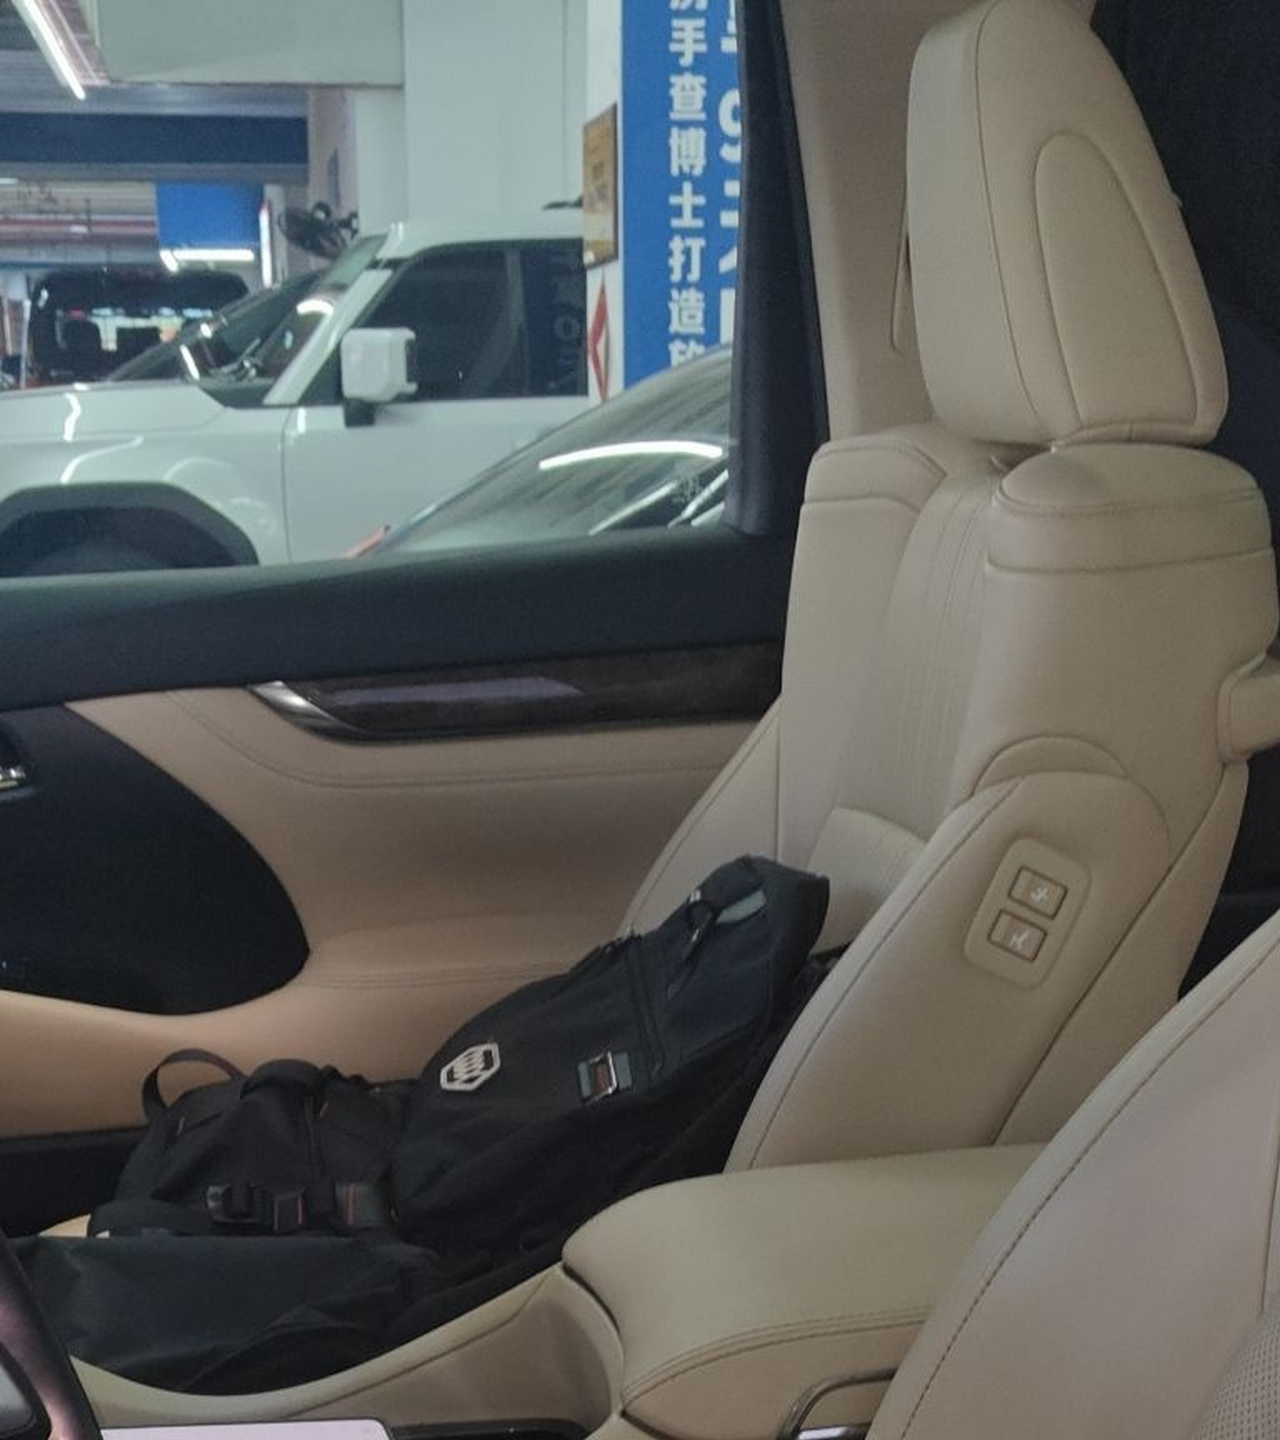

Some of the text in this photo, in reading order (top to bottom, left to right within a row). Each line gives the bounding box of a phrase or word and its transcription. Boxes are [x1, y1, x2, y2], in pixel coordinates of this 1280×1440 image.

[668, 0, 708, 368] 手查博士打造
